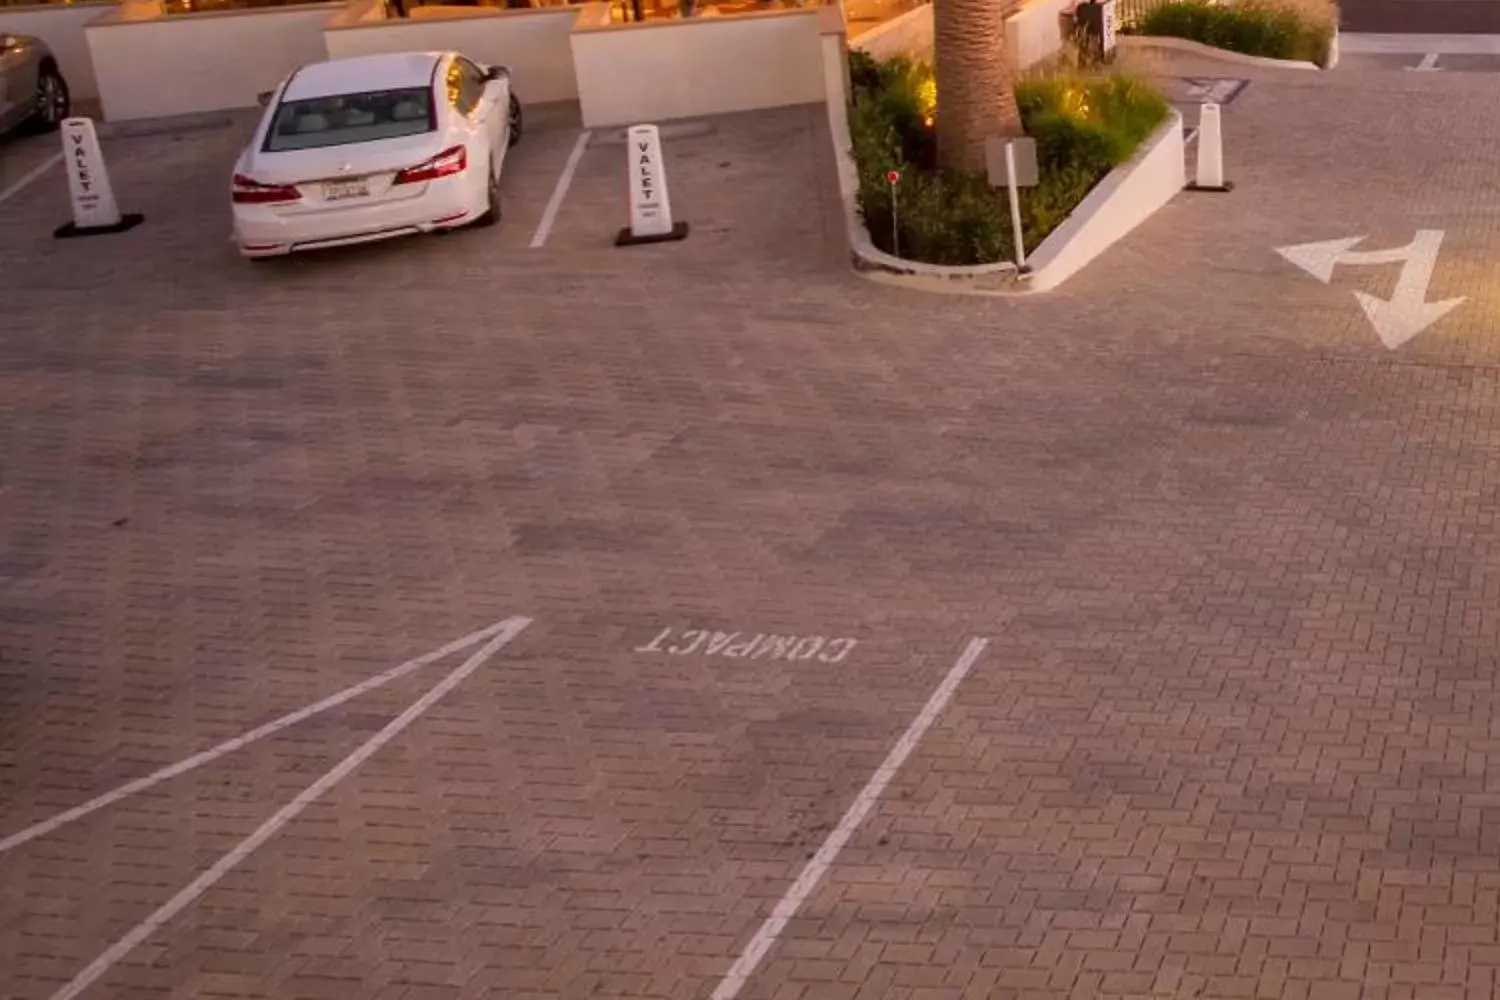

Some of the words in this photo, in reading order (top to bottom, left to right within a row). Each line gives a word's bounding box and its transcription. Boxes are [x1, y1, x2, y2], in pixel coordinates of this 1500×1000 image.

[71, 134, 91, 191] VALET
[638, 142, 653, 199] VALET
[633, 626, 858, 663] COMPACT
